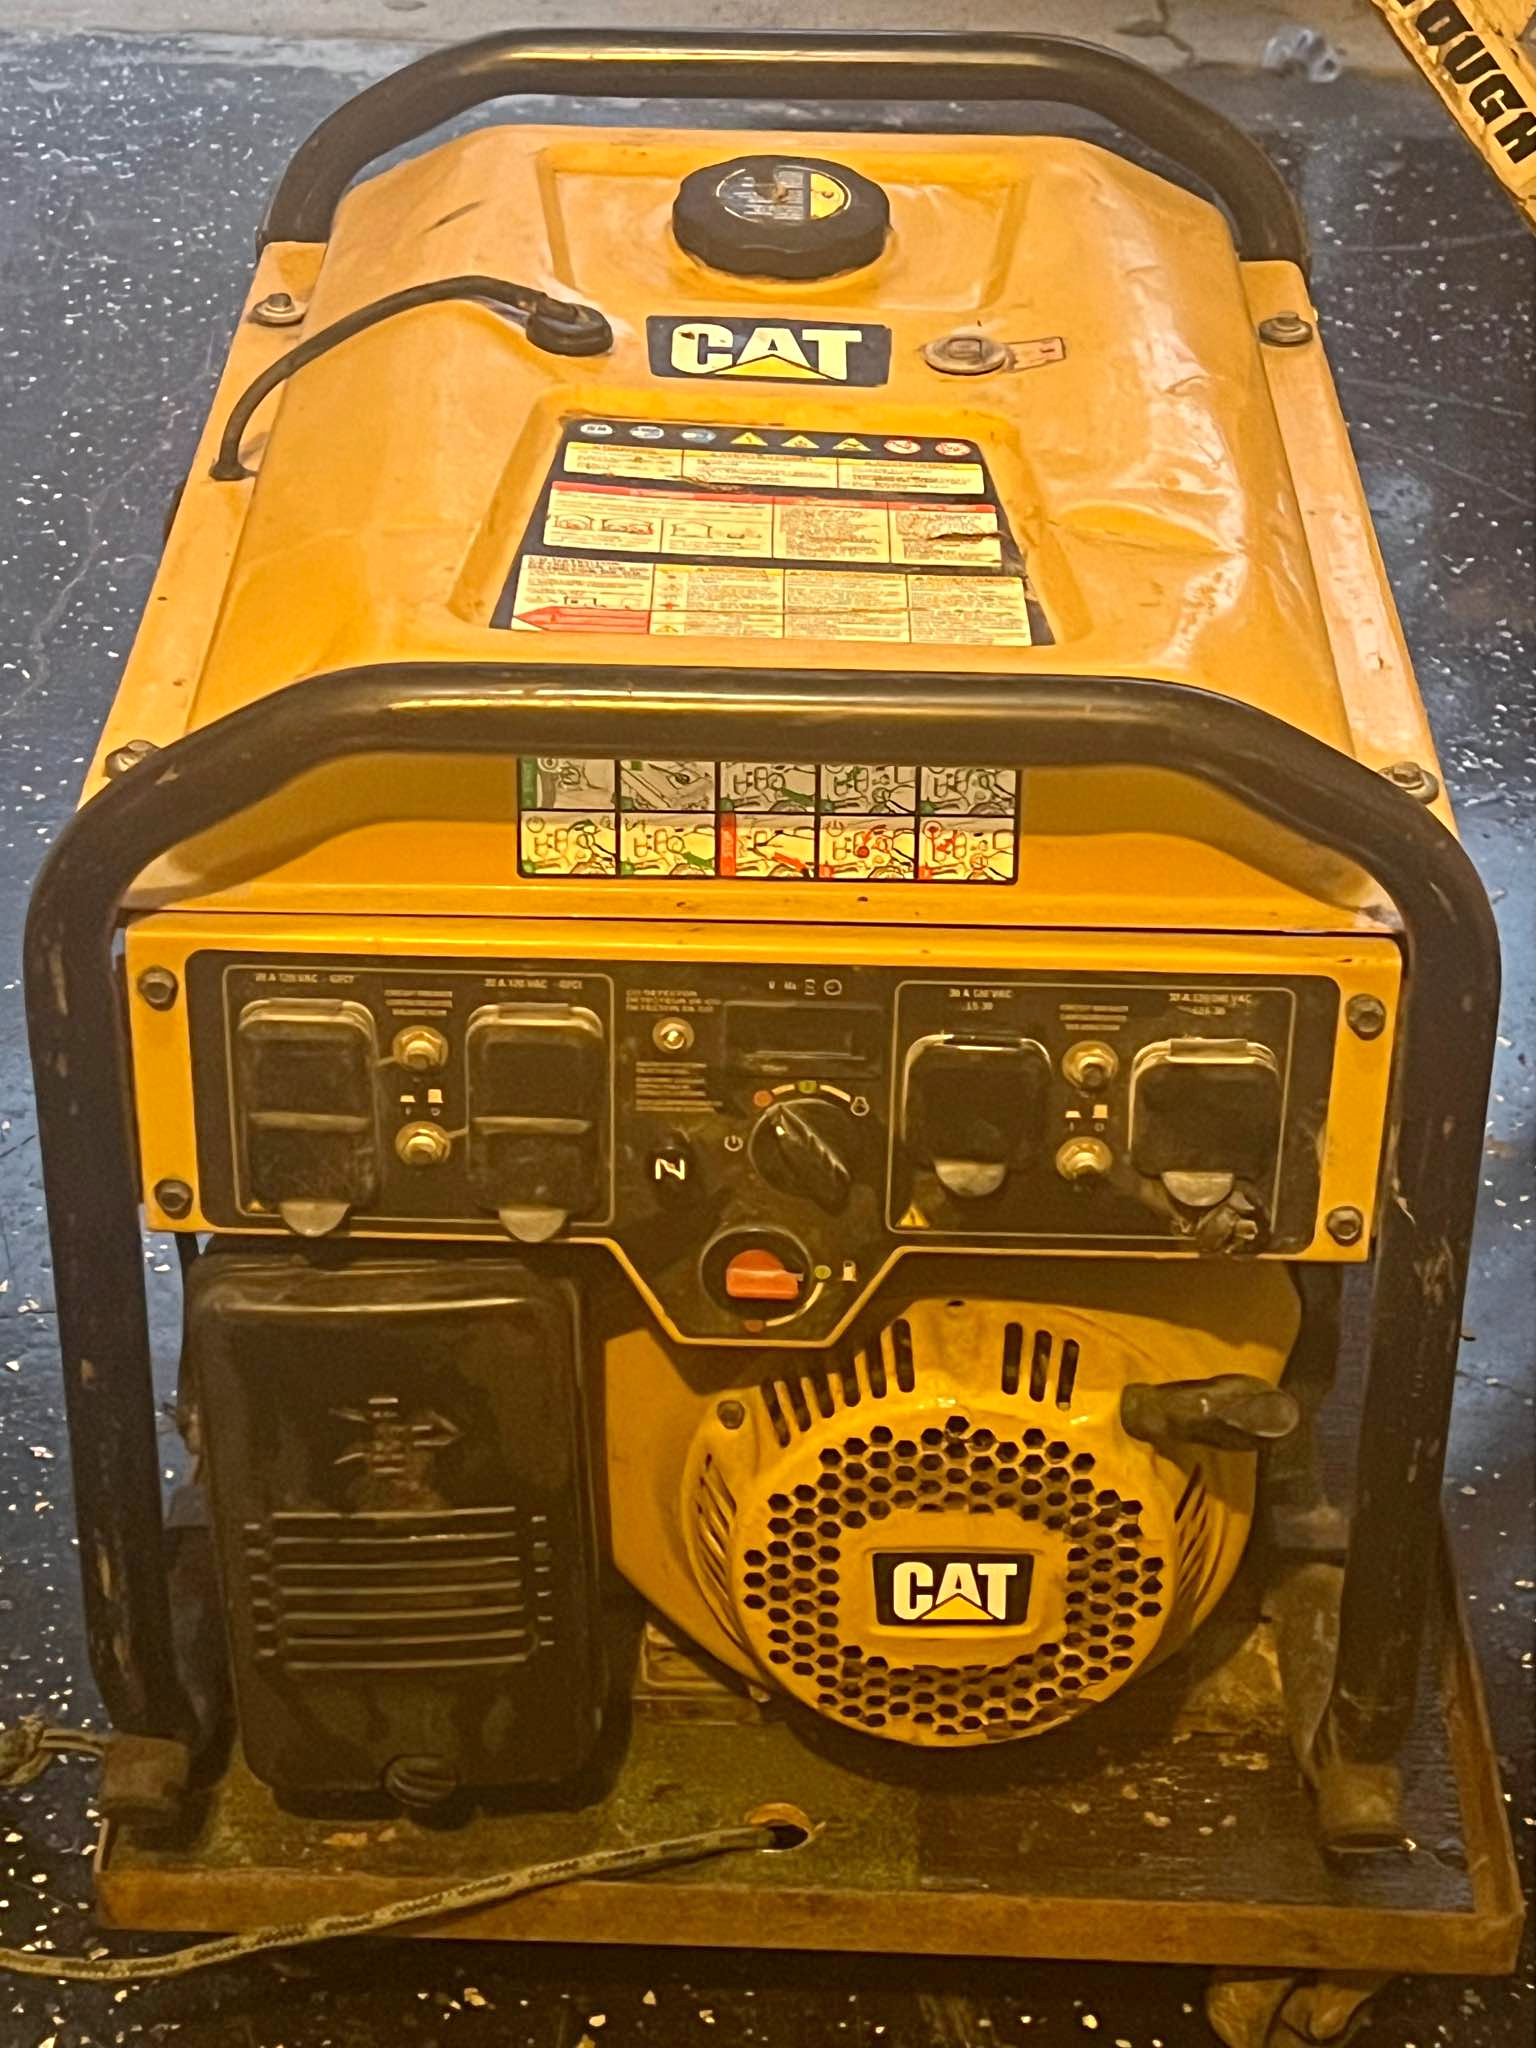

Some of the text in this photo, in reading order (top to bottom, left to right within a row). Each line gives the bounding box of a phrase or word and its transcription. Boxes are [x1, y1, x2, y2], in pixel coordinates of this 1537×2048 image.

[1397, 0, 1536, 164] OUGH
[671, 323, 862, 380] CAT
[893, 1561, 1018, 1620] CAT
